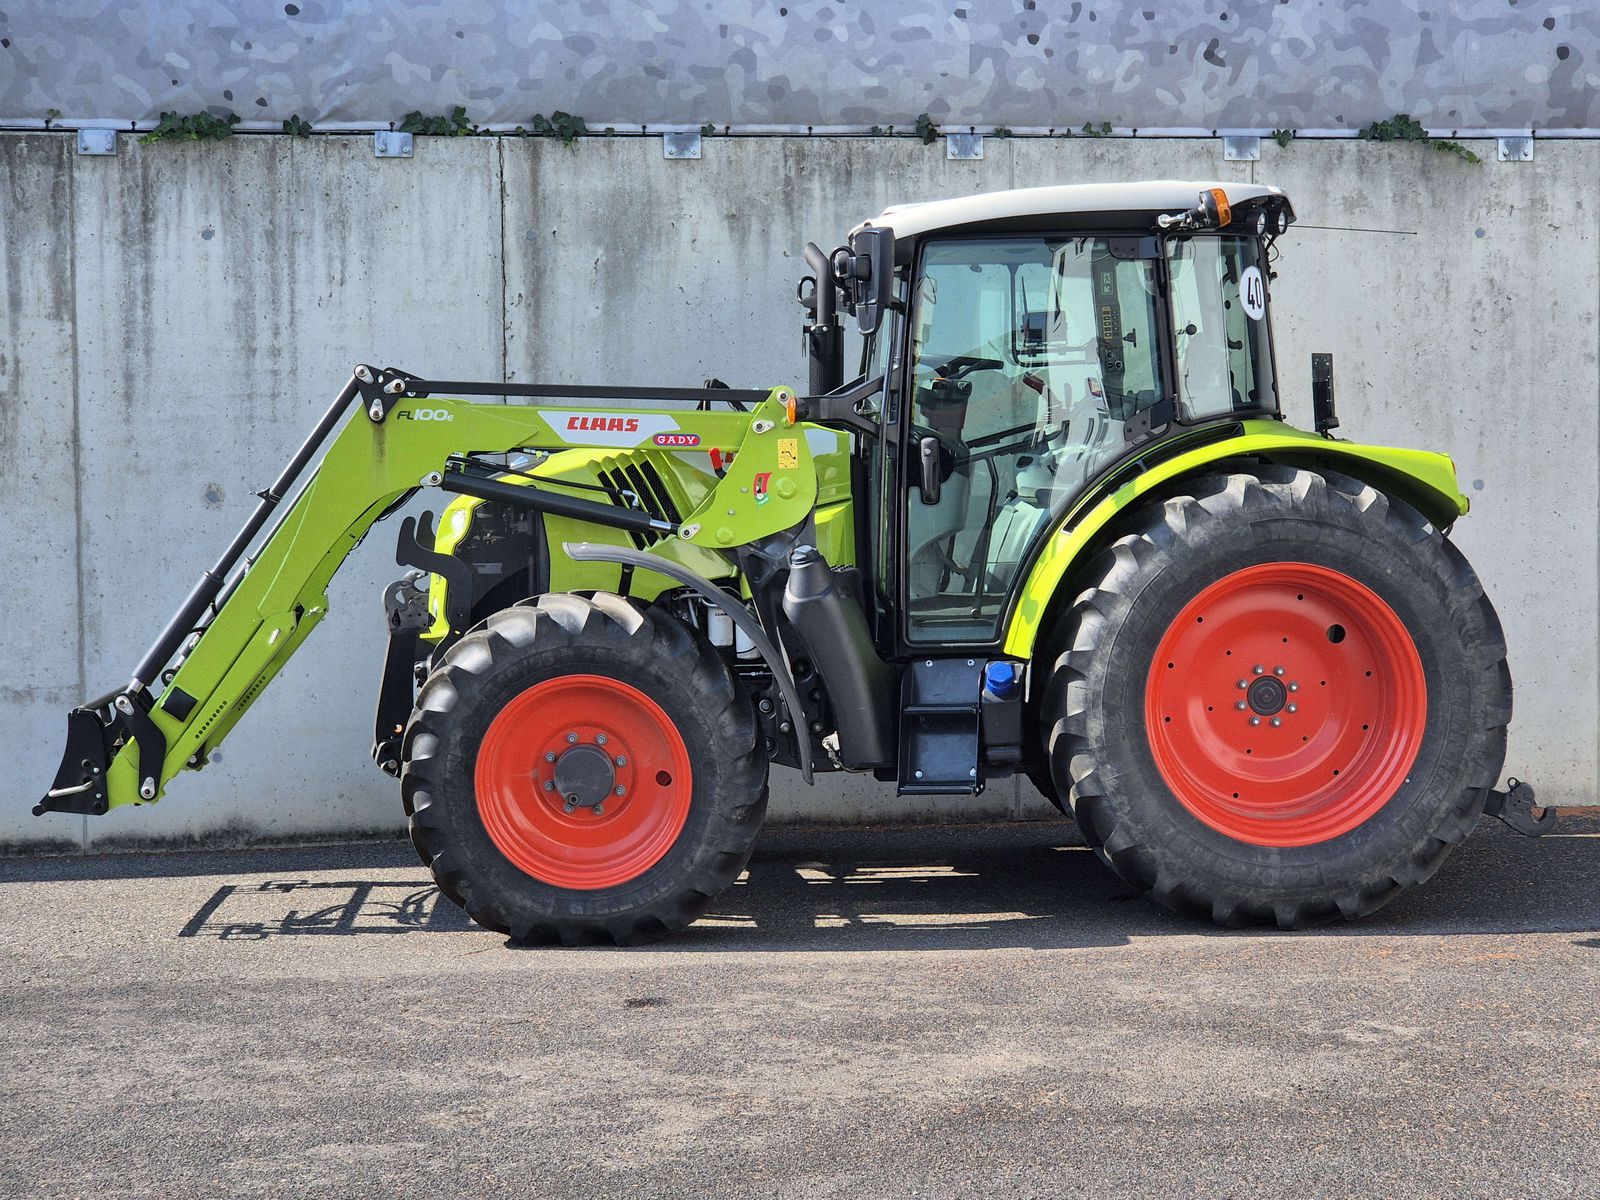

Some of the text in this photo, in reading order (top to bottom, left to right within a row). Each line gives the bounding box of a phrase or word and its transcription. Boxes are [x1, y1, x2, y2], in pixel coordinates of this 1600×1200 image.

[1247, 276, 1262, 309] 40
[566, 416, 639, 432] CLAAS
[657, 436, 696, 445] GADY
